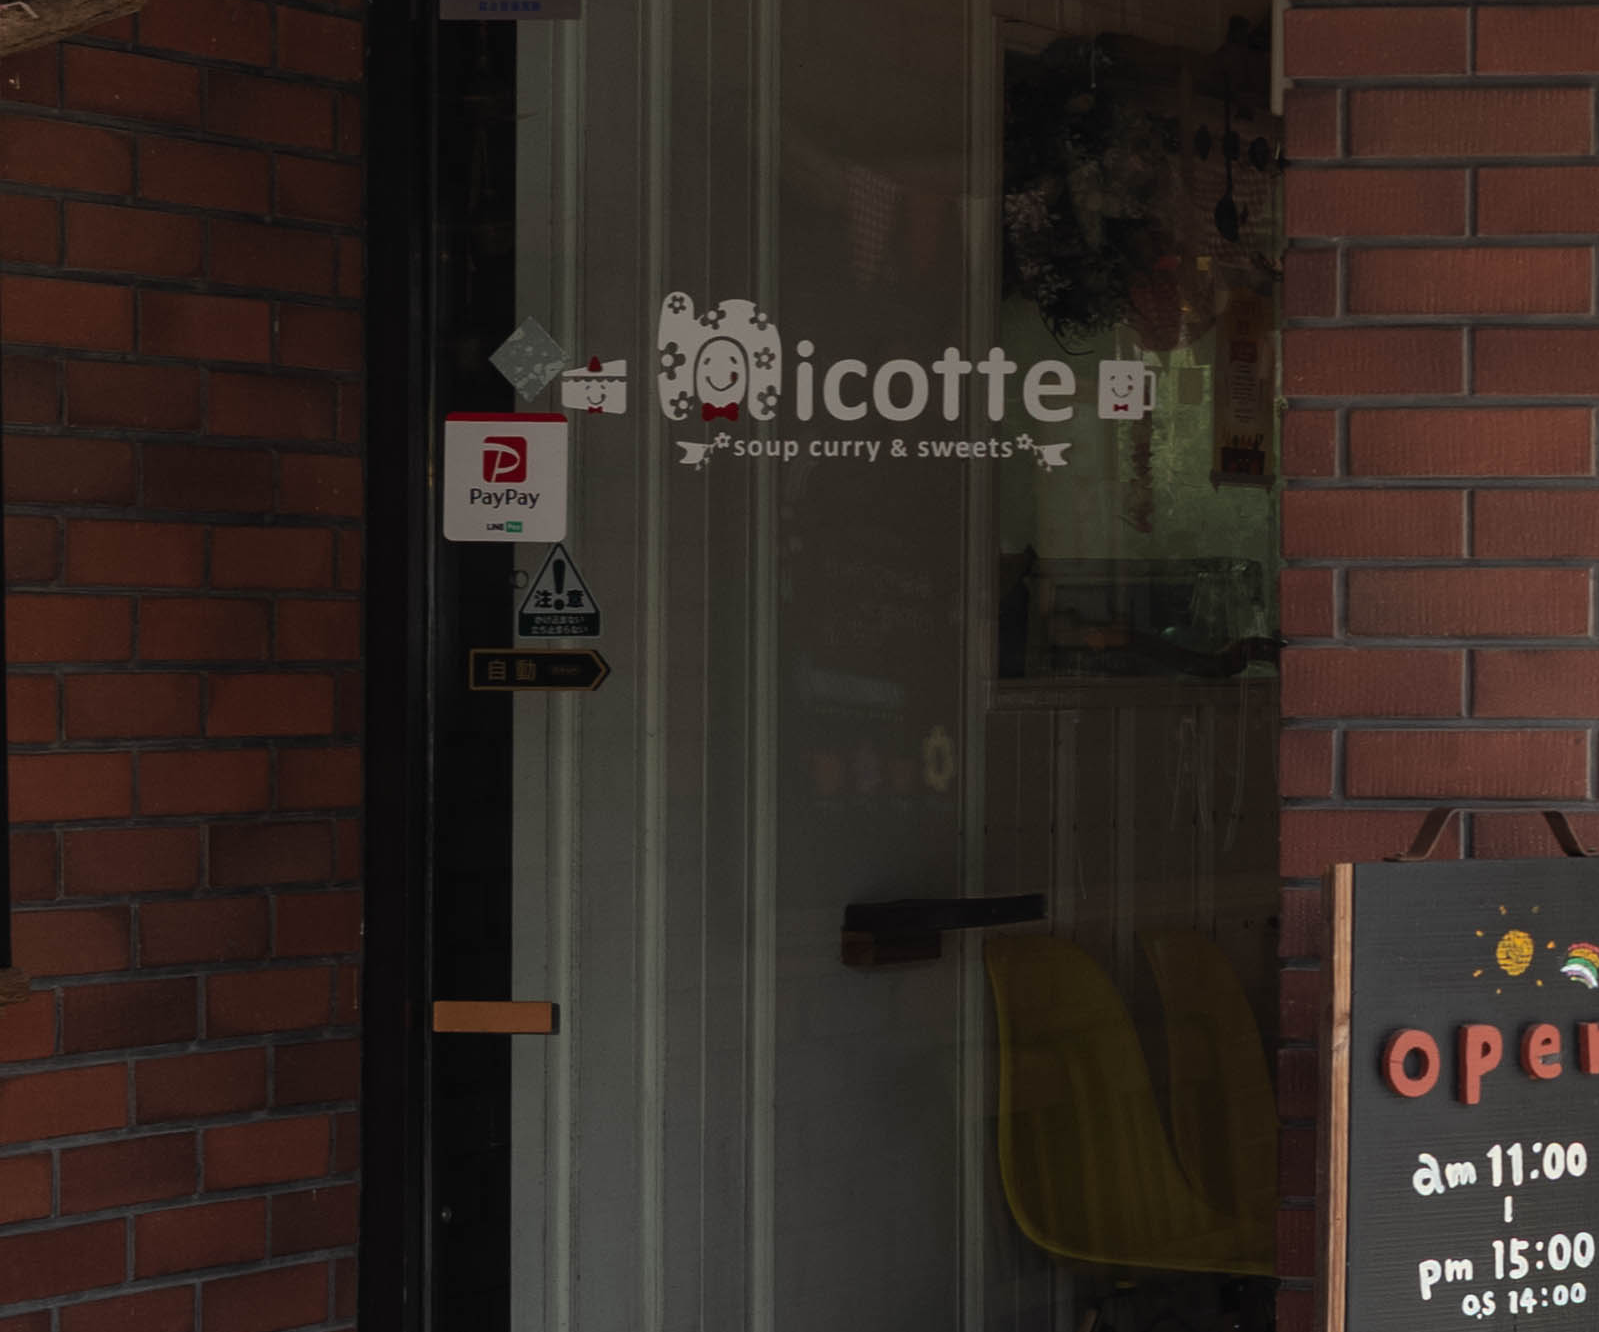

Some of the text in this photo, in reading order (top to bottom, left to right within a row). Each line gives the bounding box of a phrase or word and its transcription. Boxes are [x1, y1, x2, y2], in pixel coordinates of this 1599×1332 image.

[733, 437, 1014, 462] soup curry & sweets
[470, 488, 540, 509] PayPay
[486, 523, 504, 531] LINE
[534, 589, 585, 609] 注意
[1412, 1142, 1588, 1196] am 11:00
[1419, 1232, 1596, 1301] pm 15:00
[1508, 1282, 1587, 1315] 14:00
